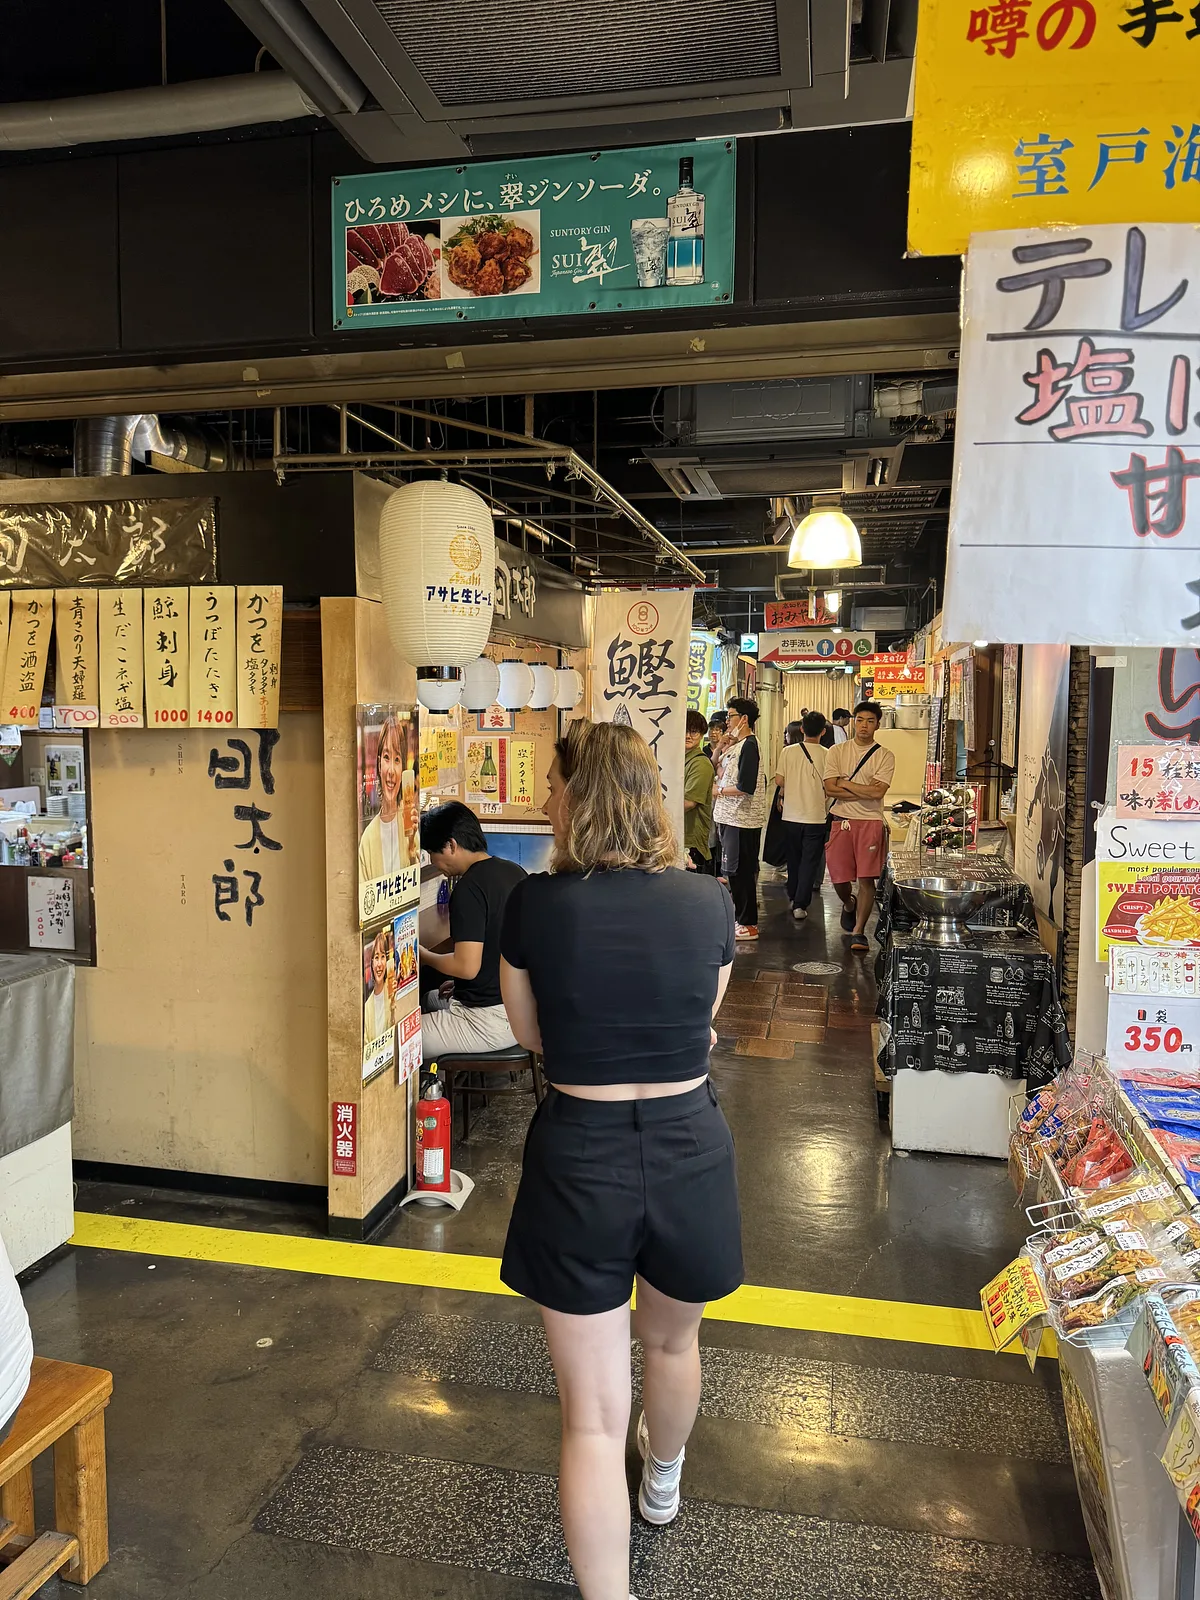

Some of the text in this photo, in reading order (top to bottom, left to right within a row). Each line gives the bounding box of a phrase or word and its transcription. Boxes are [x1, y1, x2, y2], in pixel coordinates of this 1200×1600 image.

[966, 0, 1200, 58] 噂の手
[344, 169, 661, 222] ひろめメシに、翠ジンソーダ。
[550, 225, 611, 238] SUNTORY GIN
[552, 253, 582, 269] SUI
[448, 571, 480, 586] Asahi
[246, 593, 269, 653] かつを
[152, 596, 178, 688] 鯨刺身
[204, 591, 222, 698] うつぼたたき
[781, 639, 814, 648] お手洗い
[58, 708, 97, 724] 700
[109, 714, 138, 725] 800
[154, 709, 188, 723] 1000
[197, 709, 233, 723] 1400
[1119, 789, 1200, 811] 味が楽しめ
[1108, 825, 1195, 860] Sweet
[1107, 883, 1150, 893] SWEET
[1128, 960, 1137, 984] ゆず
[1140, 960, 1149, 986] しょうが
[1151, 961, 1159, 981] のり
[1174, 962, 1182, 990] シナモン
[1184, 963, 1196, 982] 甘口
[336, 1104, 353, 1158] 消火器
